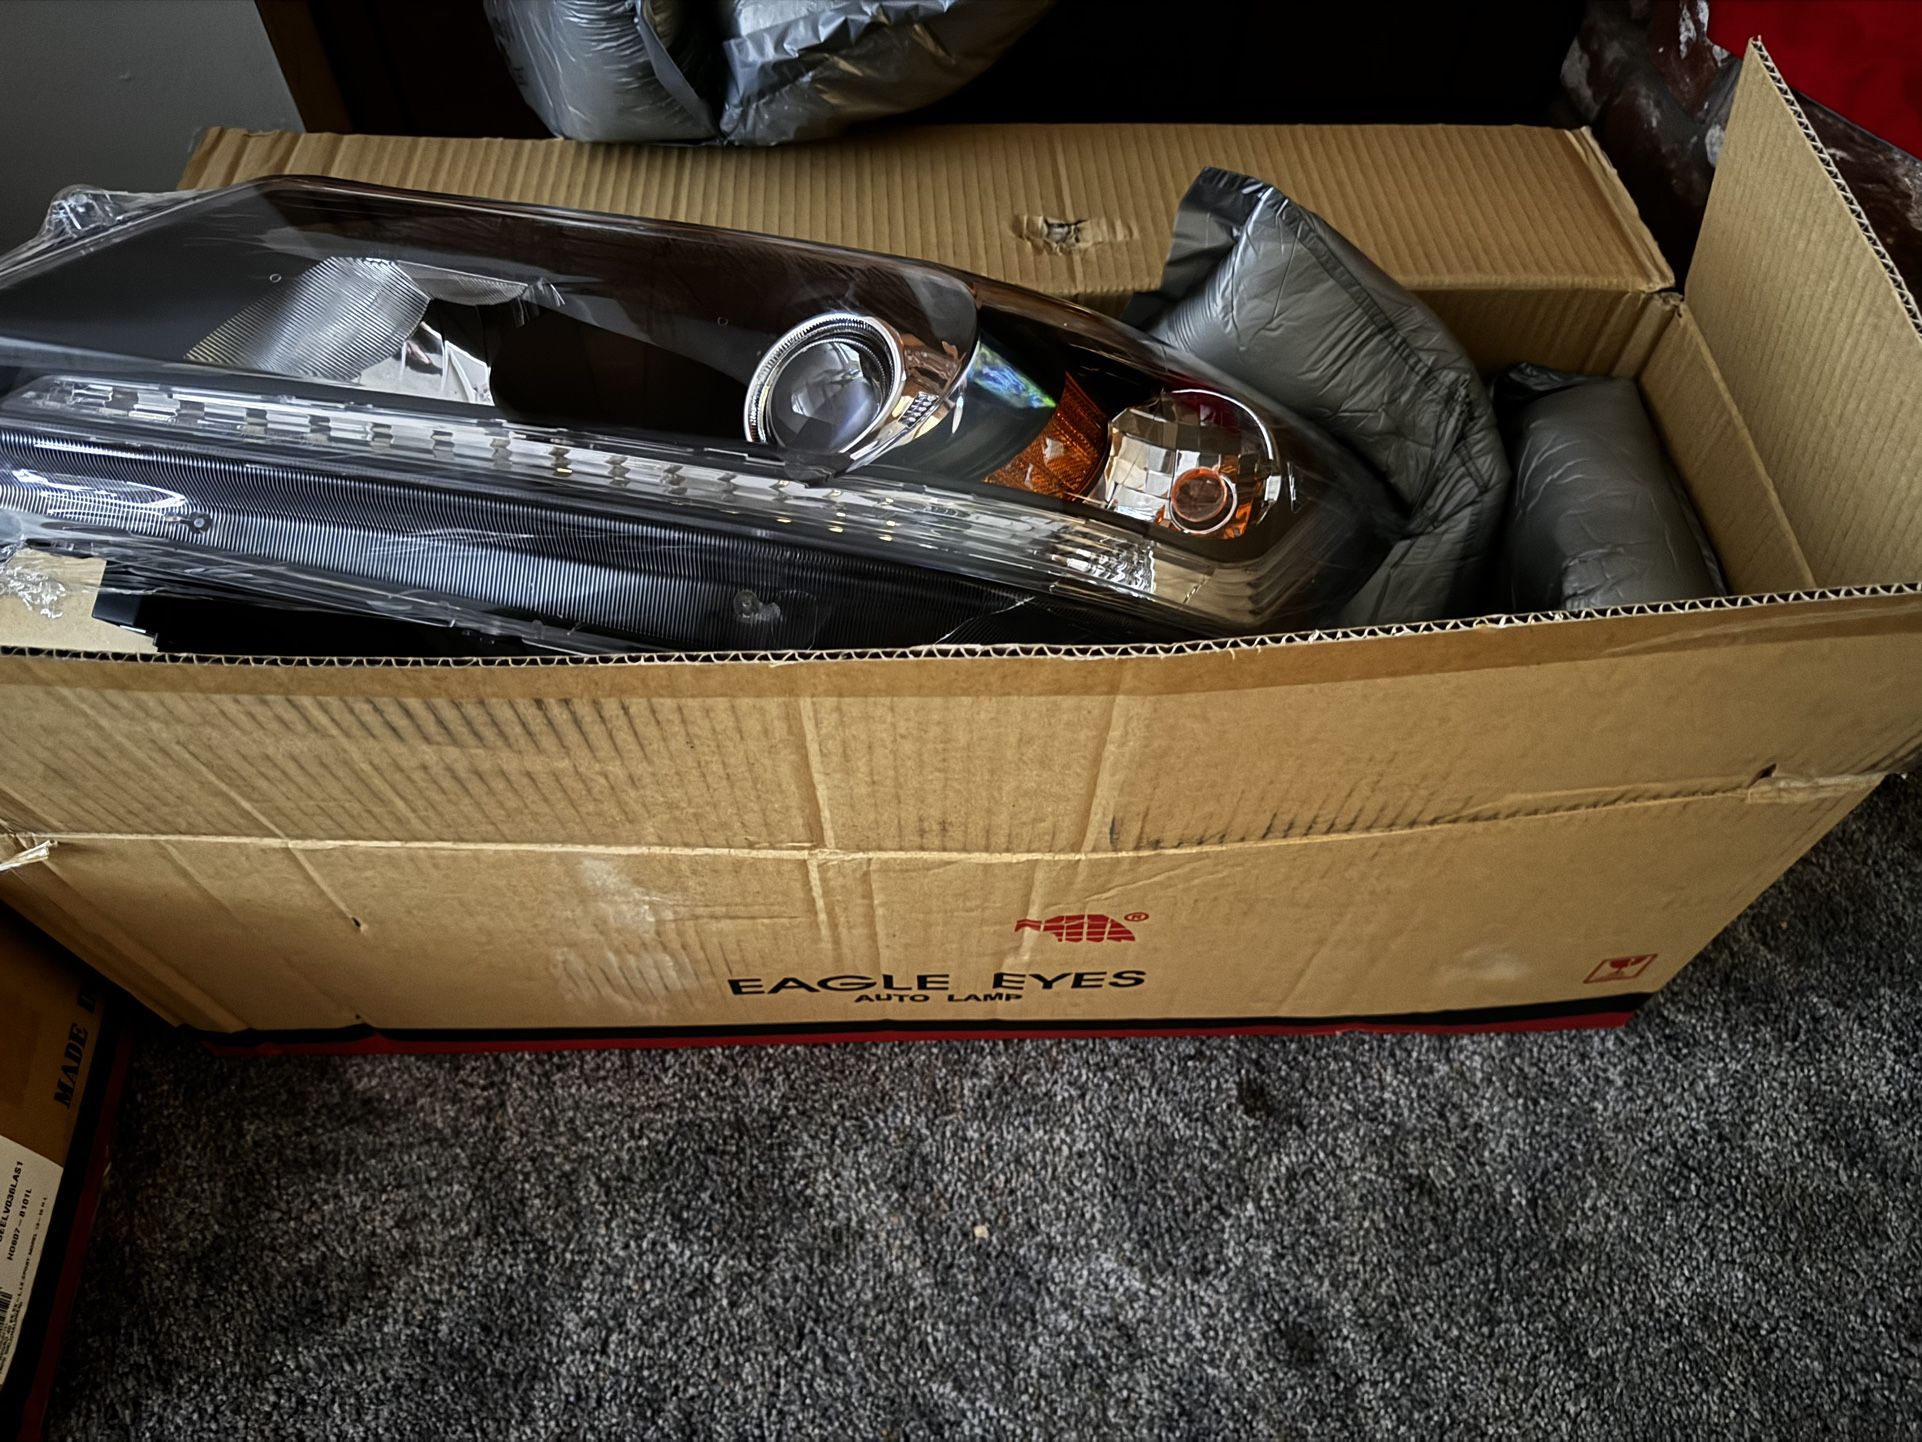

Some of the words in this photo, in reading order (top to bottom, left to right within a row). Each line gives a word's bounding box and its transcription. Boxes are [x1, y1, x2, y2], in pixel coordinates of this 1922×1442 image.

[728, 974, 949, 995] EAGLE
[993, 970, 1146, 990] EYES
[854, 993, 930, 1003] AUTO
[947, 992, 1023, 1003] LAMP
[53, 1022, 89, 1110] MADE
